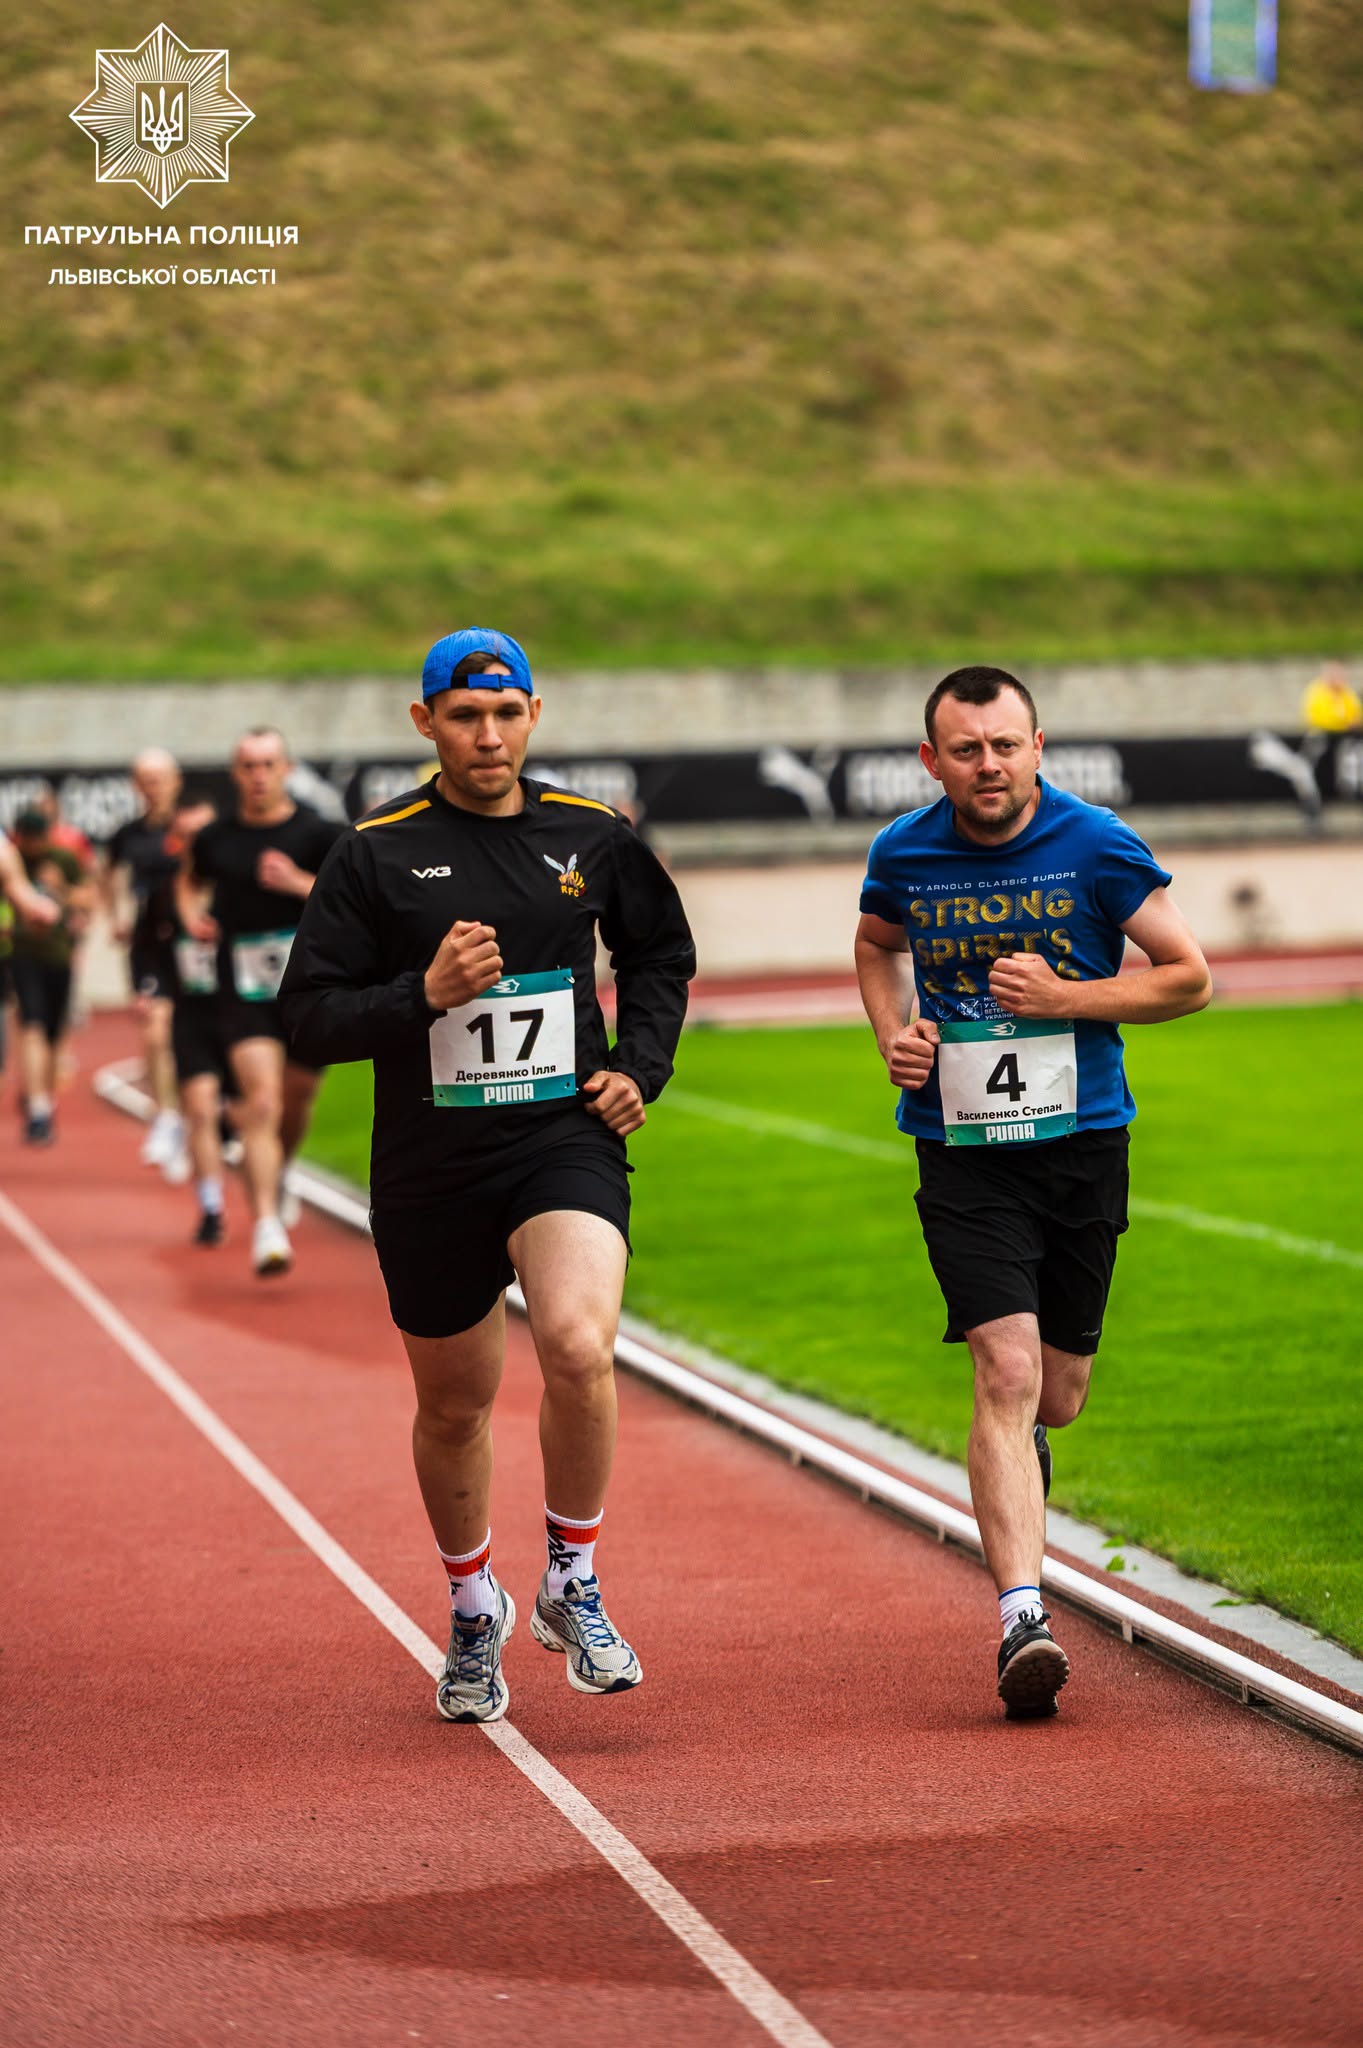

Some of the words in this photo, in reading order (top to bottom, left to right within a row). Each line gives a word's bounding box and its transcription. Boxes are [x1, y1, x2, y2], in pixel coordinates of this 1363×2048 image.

[560, 885, 579, 898] RFC
[908, 885, 921, 893] BY
[926, 882, 972, 892] ARNOLD
[978, 877, 1028, 888] CLASSIC
[1032, 871, 1077, 882] EUROPE
[909, 888, 1075, 928] STRONG
[466, 1008, 544, 1064] 17
[455, 1068, 529, 1083] Деревянко
[531, 1064, 557, 1077] Ілля
[986, 1052, 1027, 1102] 4
[483, 1083, 534, 1104] PUMA
[957, 1110, 1019, 1121] Василенко
[1022, 1103, 1062, 1116] Степан
[985, 1123, 1035, 1142] PUMA
